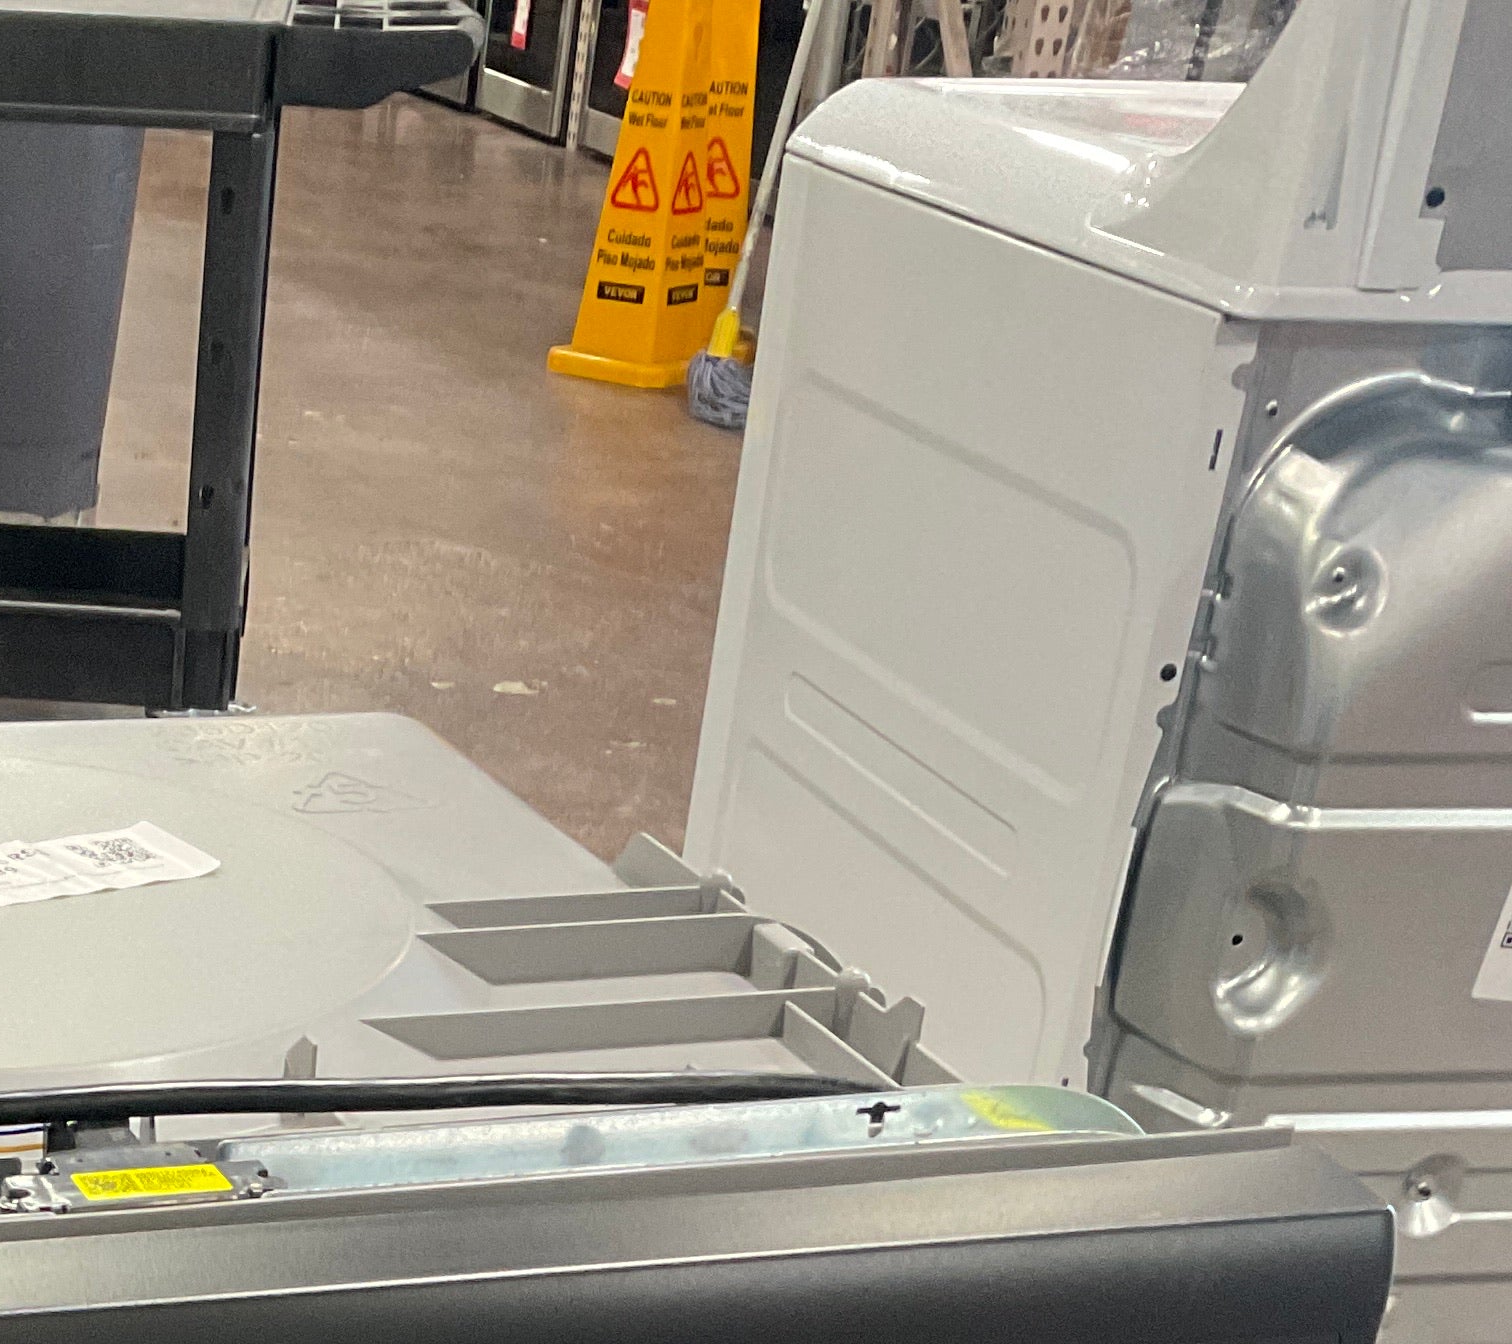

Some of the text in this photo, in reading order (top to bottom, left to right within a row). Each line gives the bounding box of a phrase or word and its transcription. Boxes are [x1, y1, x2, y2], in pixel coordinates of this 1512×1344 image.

[709, 80, 749, 96] AUTION
[631, 89, 673, 108] CAUTION
[645, 113, 669, 129] Floor
[607, 229, 652, 248] Cuidado
[596, 249, 656, 272] Piso Mojado
[603, 285, 638, 300] VEVOR
